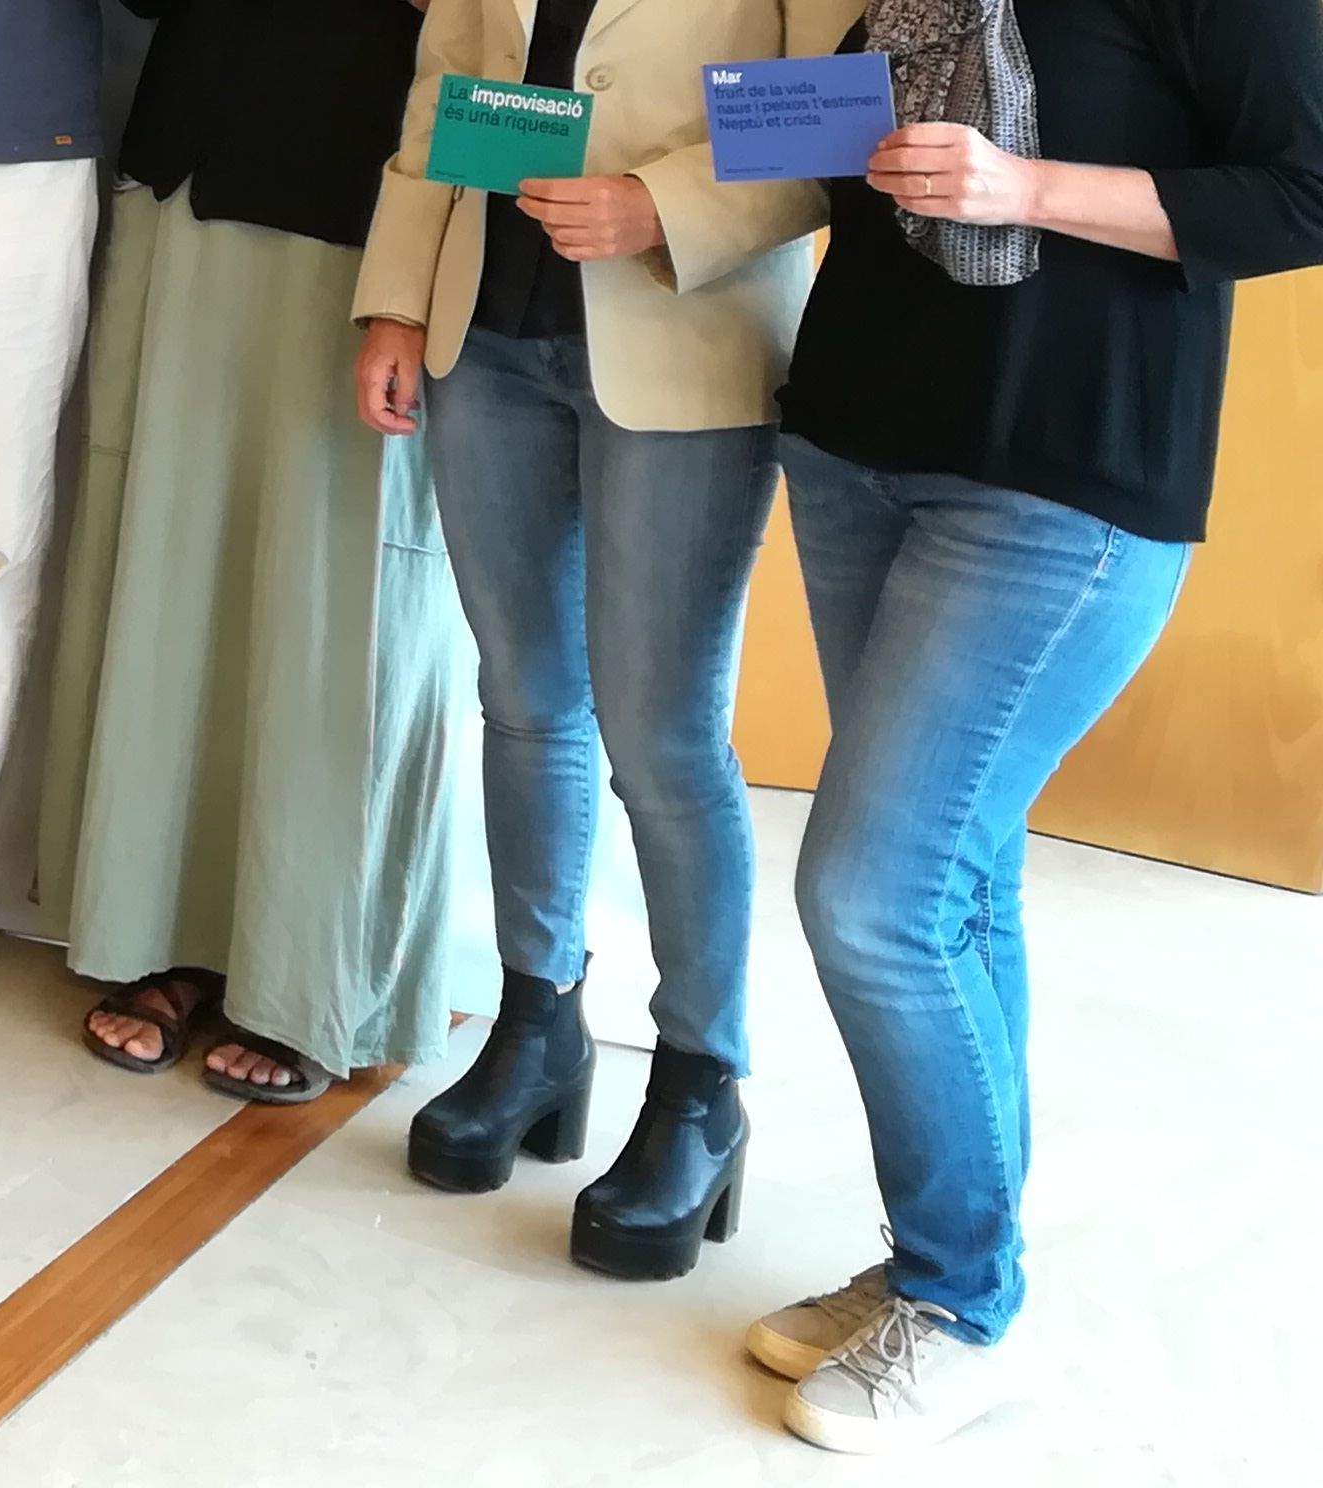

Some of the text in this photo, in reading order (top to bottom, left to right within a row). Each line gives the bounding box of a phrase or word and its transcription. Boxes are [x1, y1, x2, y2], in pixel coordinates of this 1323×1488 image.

[712, 70, 743, 85] Mar
[748, 84, 766, 97] de
[770, 82, 783, 96] la
[786, 81, 816, 95] vida
[448, 82, 583, 118] La improvisació
[717, 102, 752, 114] naus
[762, 99, 809, 114] peixos
[812, 95, 882, 110] t'estimen
[444, 106, 570, 137] és una riquesa
[766, 115, 781, 128] et
